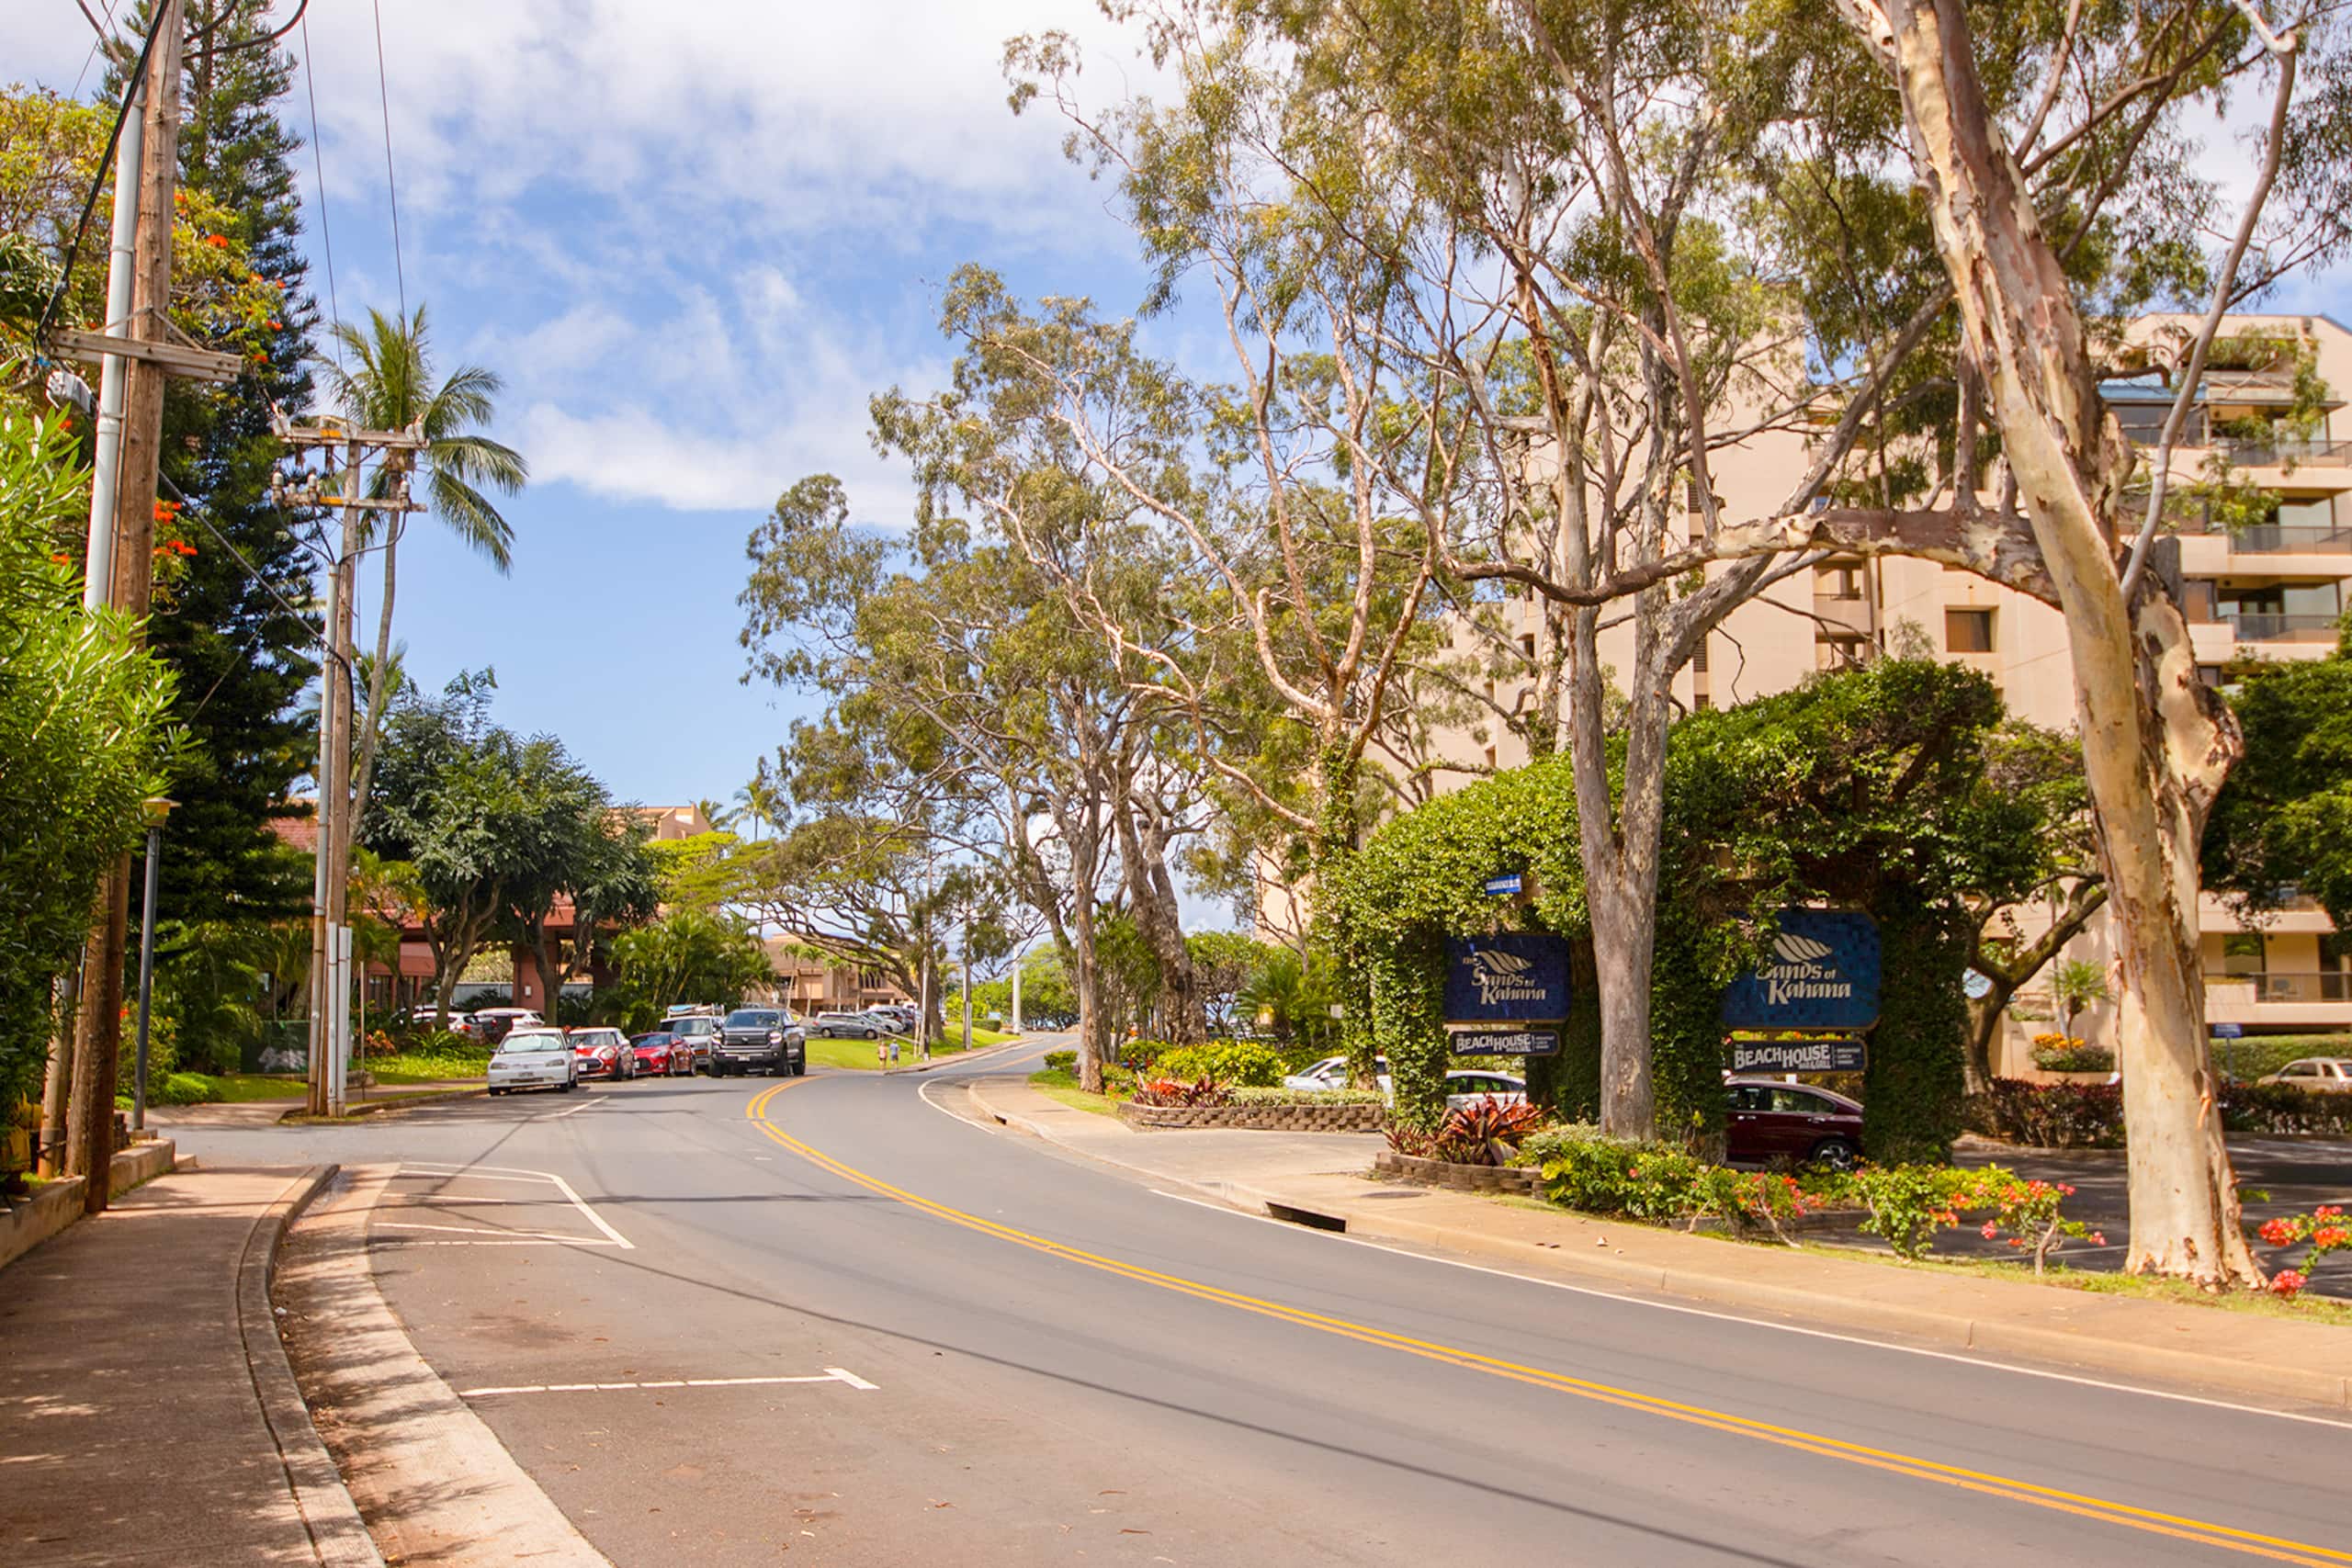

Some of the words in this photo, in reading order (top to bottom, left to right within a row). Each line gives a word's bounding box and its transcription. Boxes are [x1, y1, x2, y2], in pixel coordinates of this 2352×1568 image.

[1471, 965, 1525, 986] Sands
[1824, 969, 1837, 980] of
[1480, 985, 1546, 1005] Kahana
[1769, 979, 1852, 1006] Kahana
[1456, 1035, 1493, 1053] BEACH
[1493, 1033, 1531, 1051] HOUSE
[1734, 1047, 1781, 1070] BEACH
[1782, 1044, 1830, 1068] HOUSE
